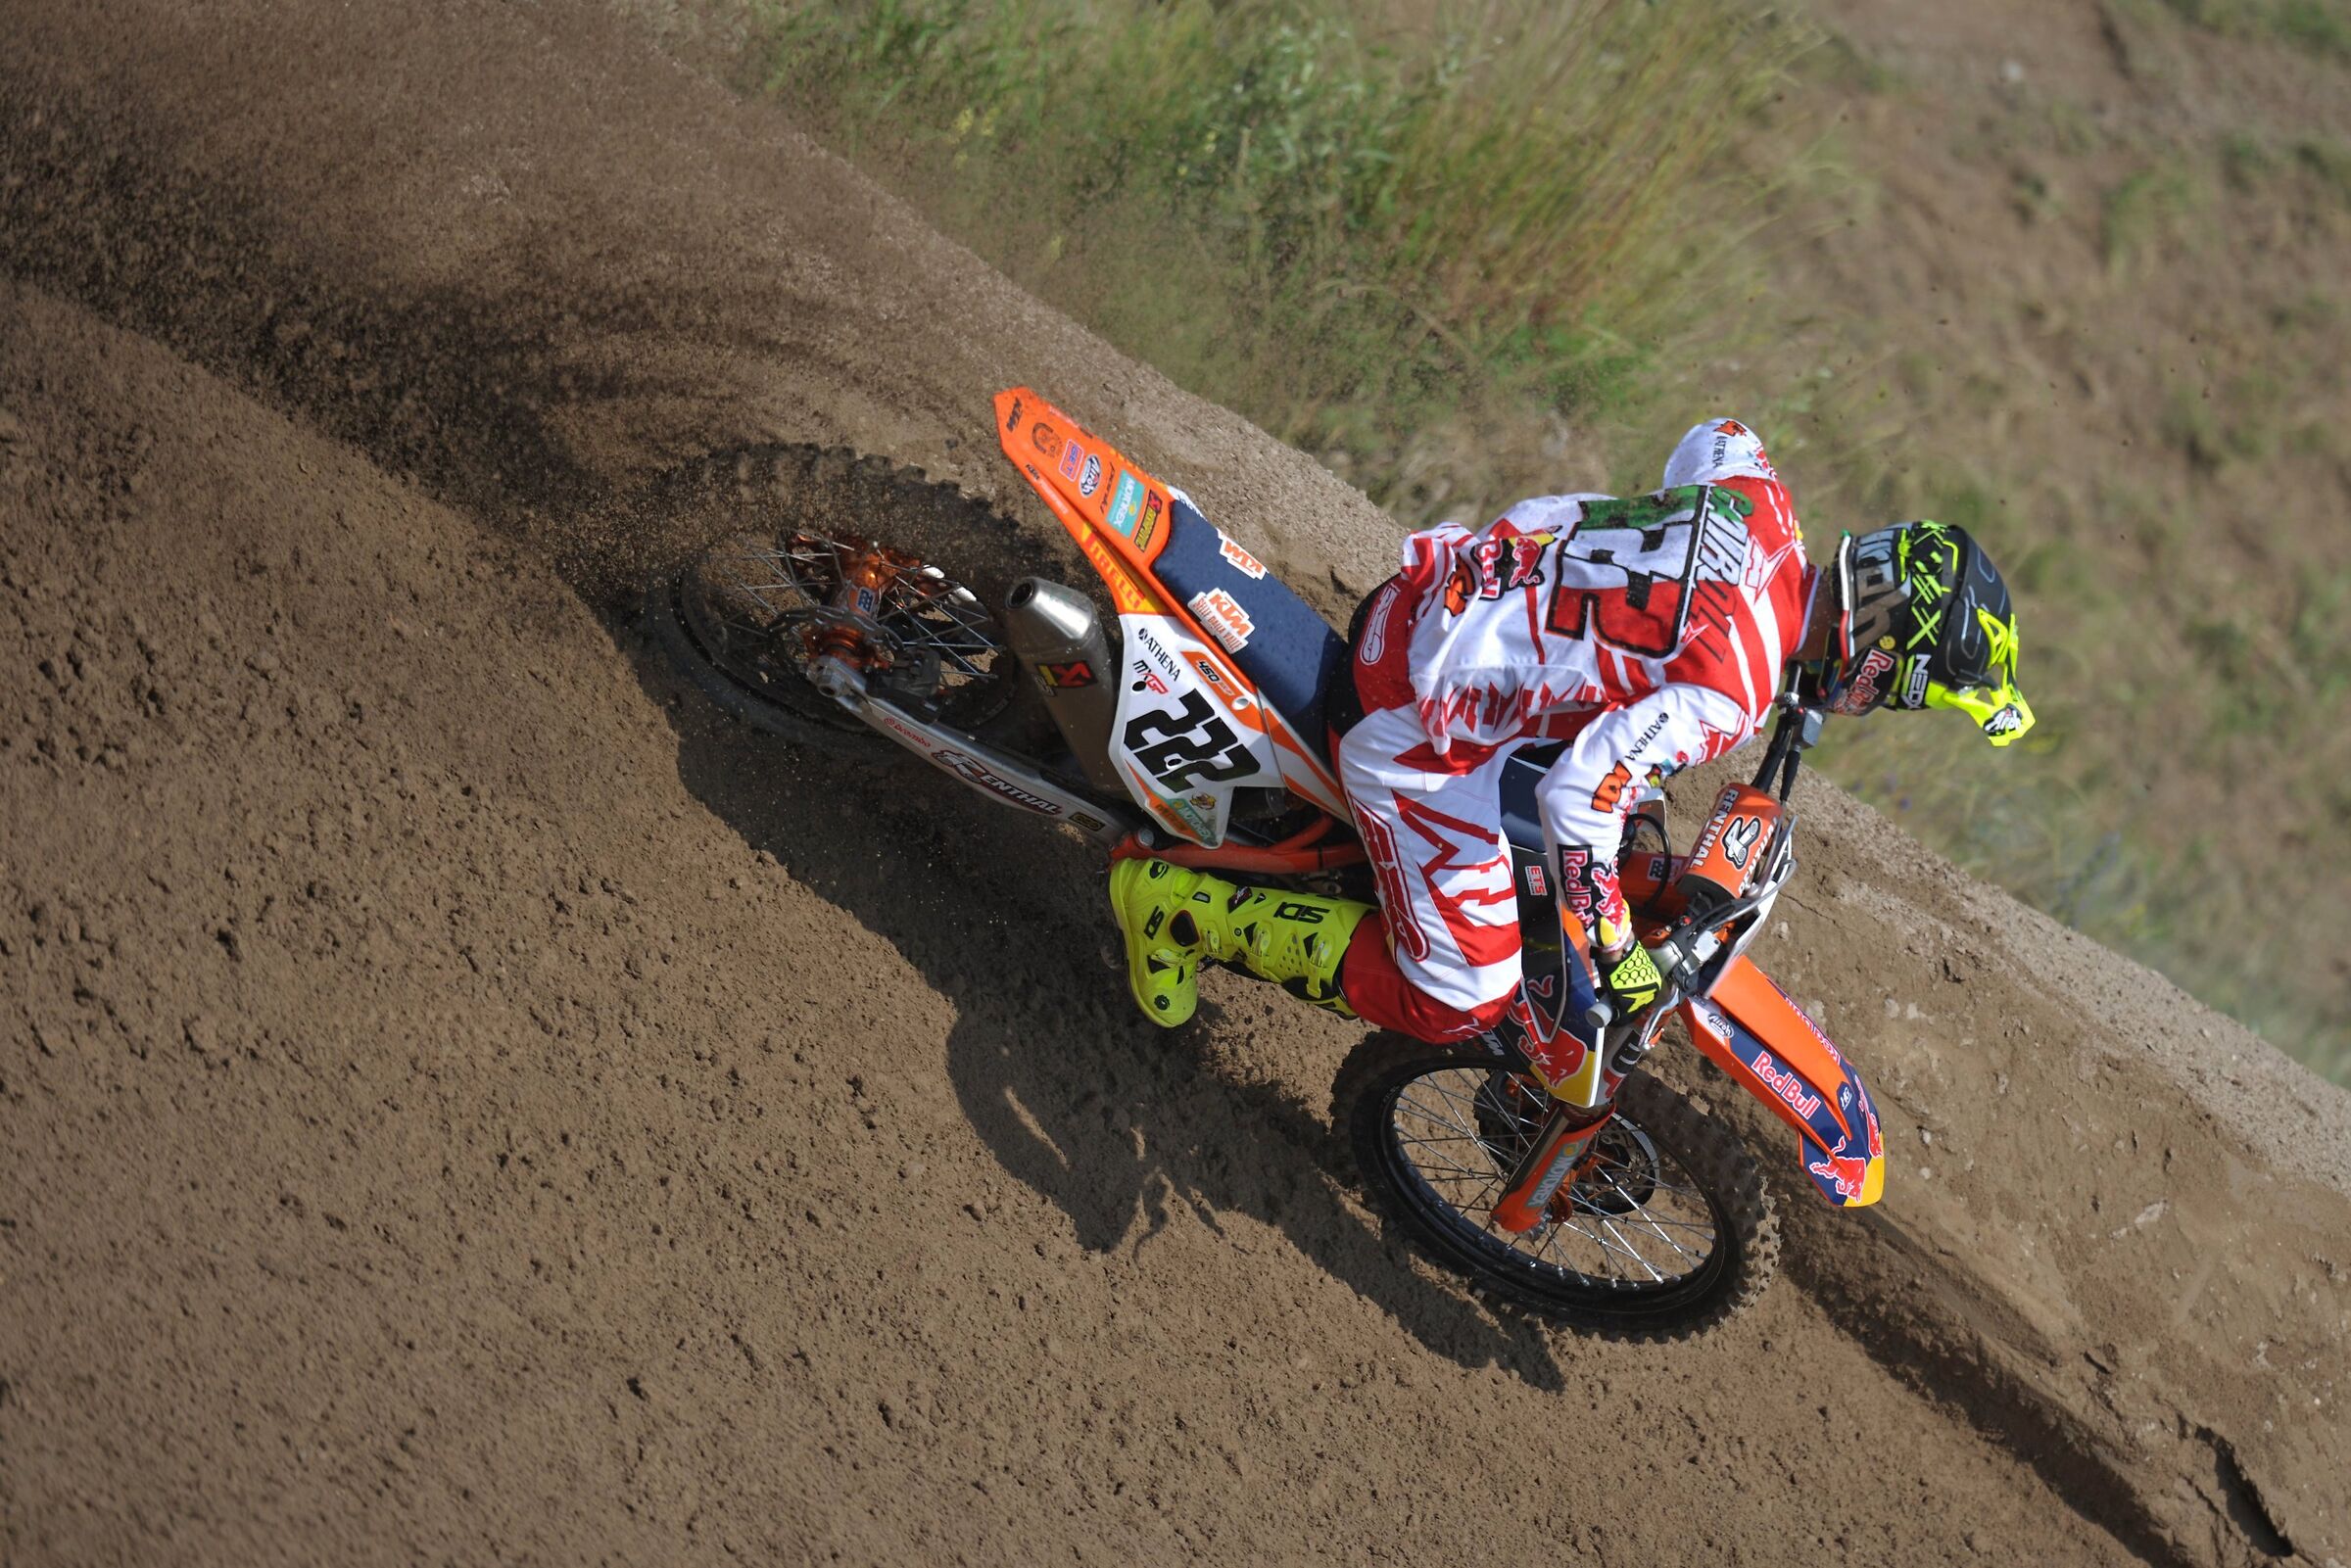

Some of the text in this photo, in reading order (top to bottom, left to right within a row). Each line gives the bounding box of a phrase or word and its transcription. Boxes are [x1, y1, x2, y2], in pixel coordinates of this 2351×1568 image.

[1224, 540, 1263, 575] KTM
[1684, 485, 1754, 664] CAIROLI
[1207, 613, 1226, 635] DALLA
[1223, 631, 1241, 652] VALLE
[1209, 594, 1250, 637] KTM
[1145, 638, 1181, 682] ATHENA
[1196, 660, 1221, 683] 450
[1124, 688, 1261, 793] 222
[1625, 721, 1662, 761] ATHENA
[1690, 788, 1740, 869] RENTHAL
[1531, 867, 1545, 893] ETS
[1562, 850, 1594, 894] Red
[1480, 1028, 1505, 1056] TM
[1751, 1051, 1793, 1093] Red
[1784, 1079, 1821, 1119] Bull
